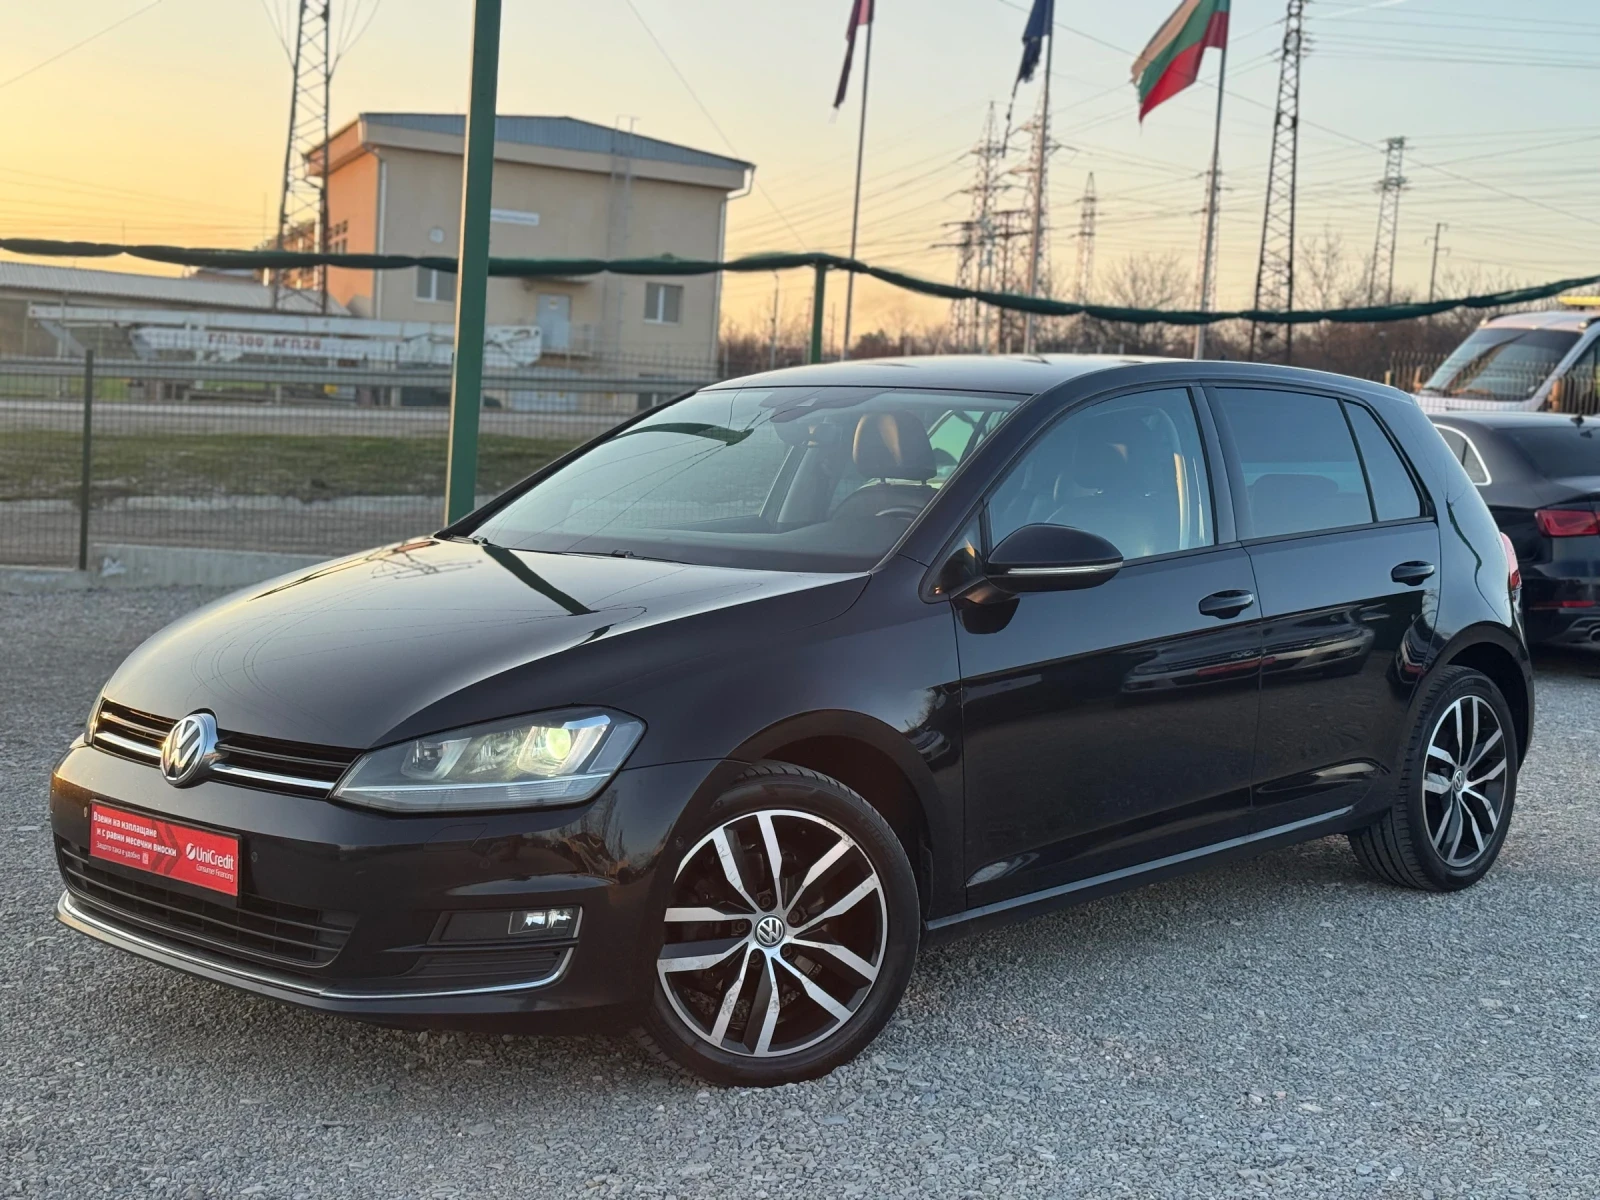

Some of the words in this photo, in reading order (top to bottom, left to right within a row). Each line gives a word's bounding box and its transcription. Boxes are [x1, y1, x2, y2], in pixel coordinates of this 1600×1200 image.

[93, 811, 112, 826] Вземи
[112, 819, 121, 828] на
[121, 821, 157, 838] изплащане
[96, 828, 101, 836] и
[101, 829, 106, 837] с
[106, 830, 125, 843] равни
[125, 836, 152, 850] месечни
[153, 843, 177, 857] вноски
[196, 846, 234, 870] UniCredit
[196, 863, 215, 876] Consumer
[215, 868, 234, 883] Financing
[756, 917, 784, 946] VW
